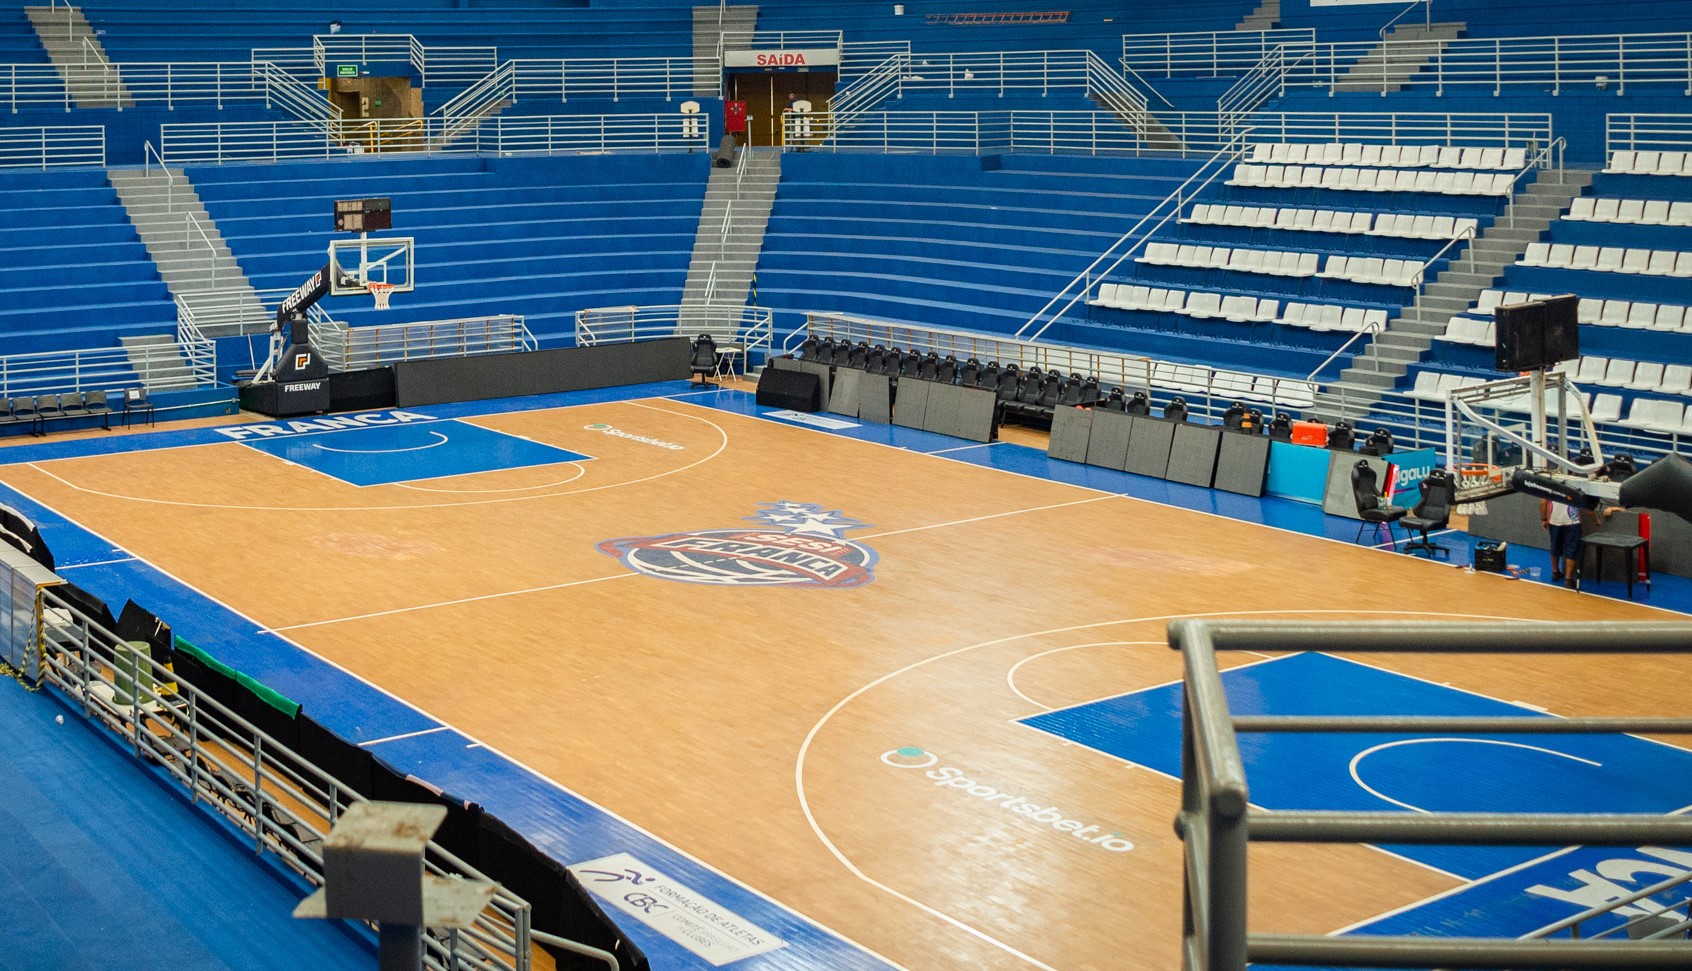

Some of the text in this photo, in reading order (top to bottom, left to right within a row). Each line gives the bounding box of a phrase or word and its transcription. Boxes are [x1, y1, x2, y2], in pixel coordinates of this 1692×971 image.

[281, 277, 317, 313] FREEWAY
[284, 382, 321, 392] FREEWAY
[214, 410, 438, 440] FRANCA
[602, 428, 684, 450] Sportsbet.io
[744, 533, 842, 553] SESI
[664, 538, 842, 577] FRANCA
[926, 767, 1134, 852] Sportsbet.io
[624, 892, 669, 914] CBC
[720, 920, 765, 945] ATLETAS
